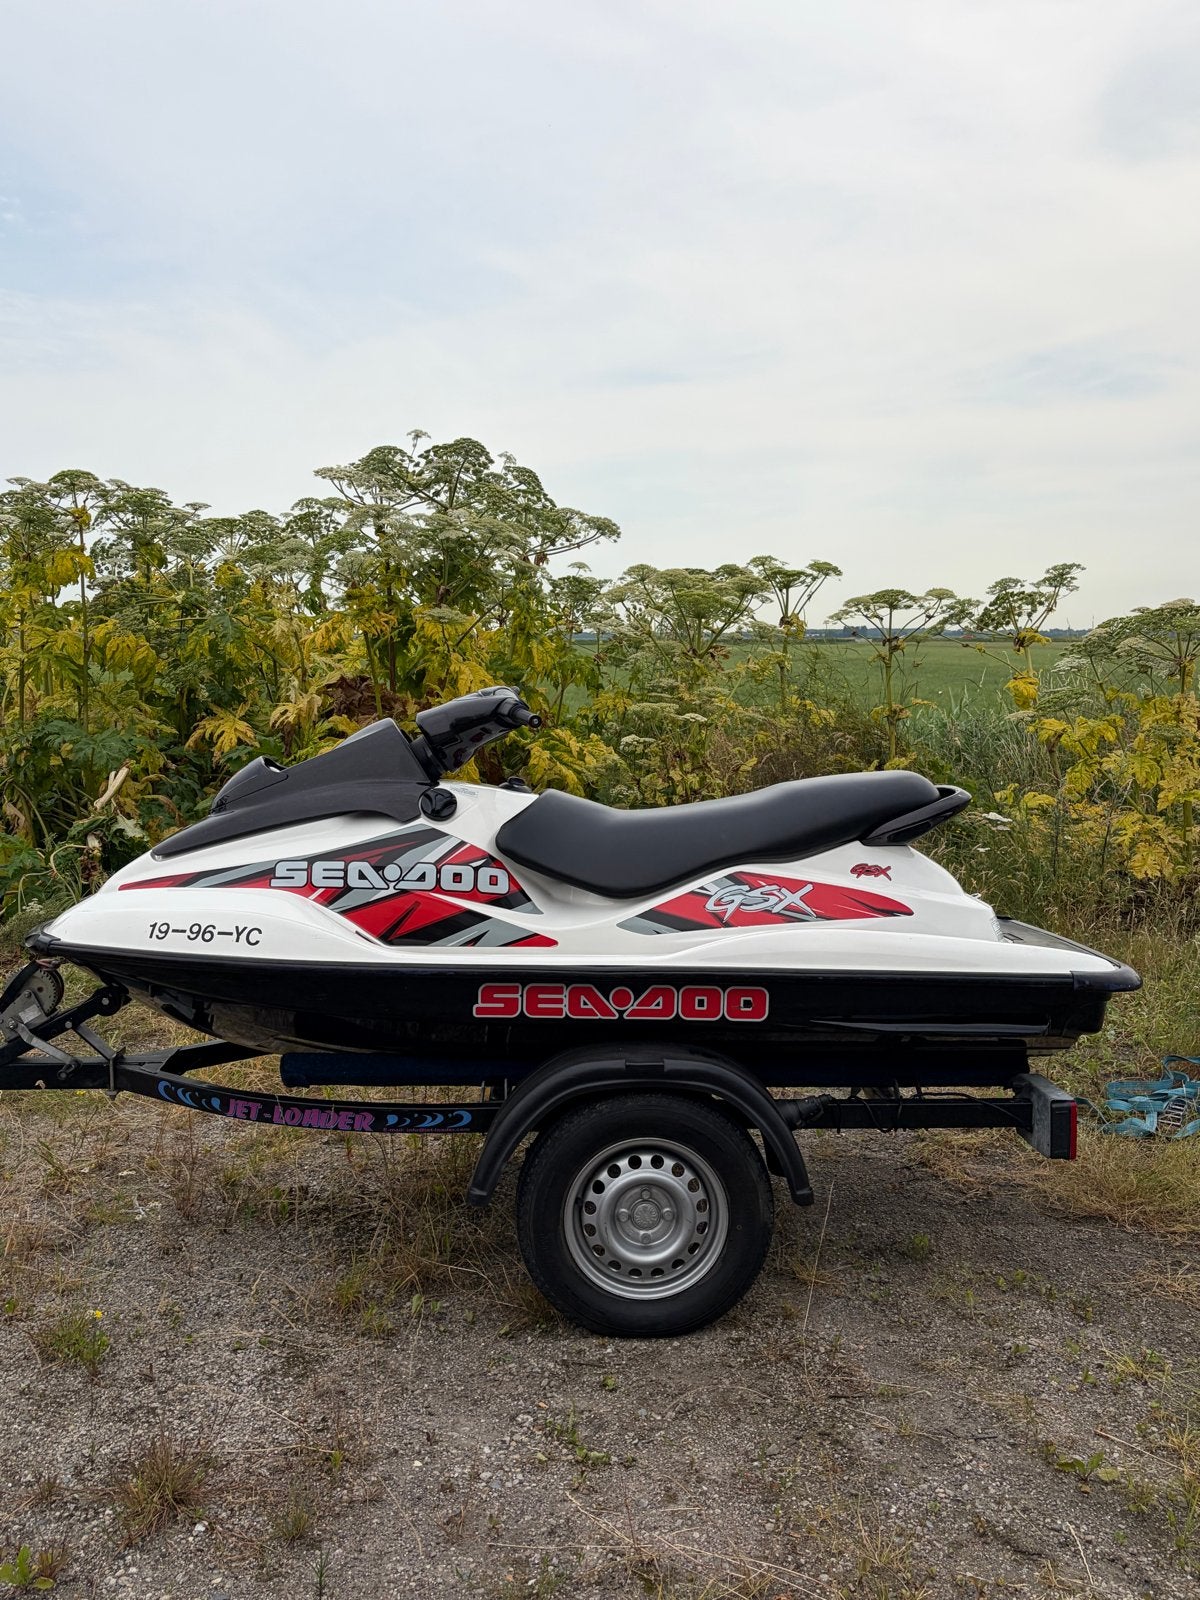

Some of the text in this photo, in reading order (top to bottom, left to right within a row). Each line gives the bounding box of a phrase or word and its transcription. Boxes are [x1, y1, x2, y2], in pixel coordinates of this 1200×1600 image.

[850, 863, 892, 881] GSX
[704, 882, 817, 923] GSX
[148, 922, 263, 946] 19-96-YC
